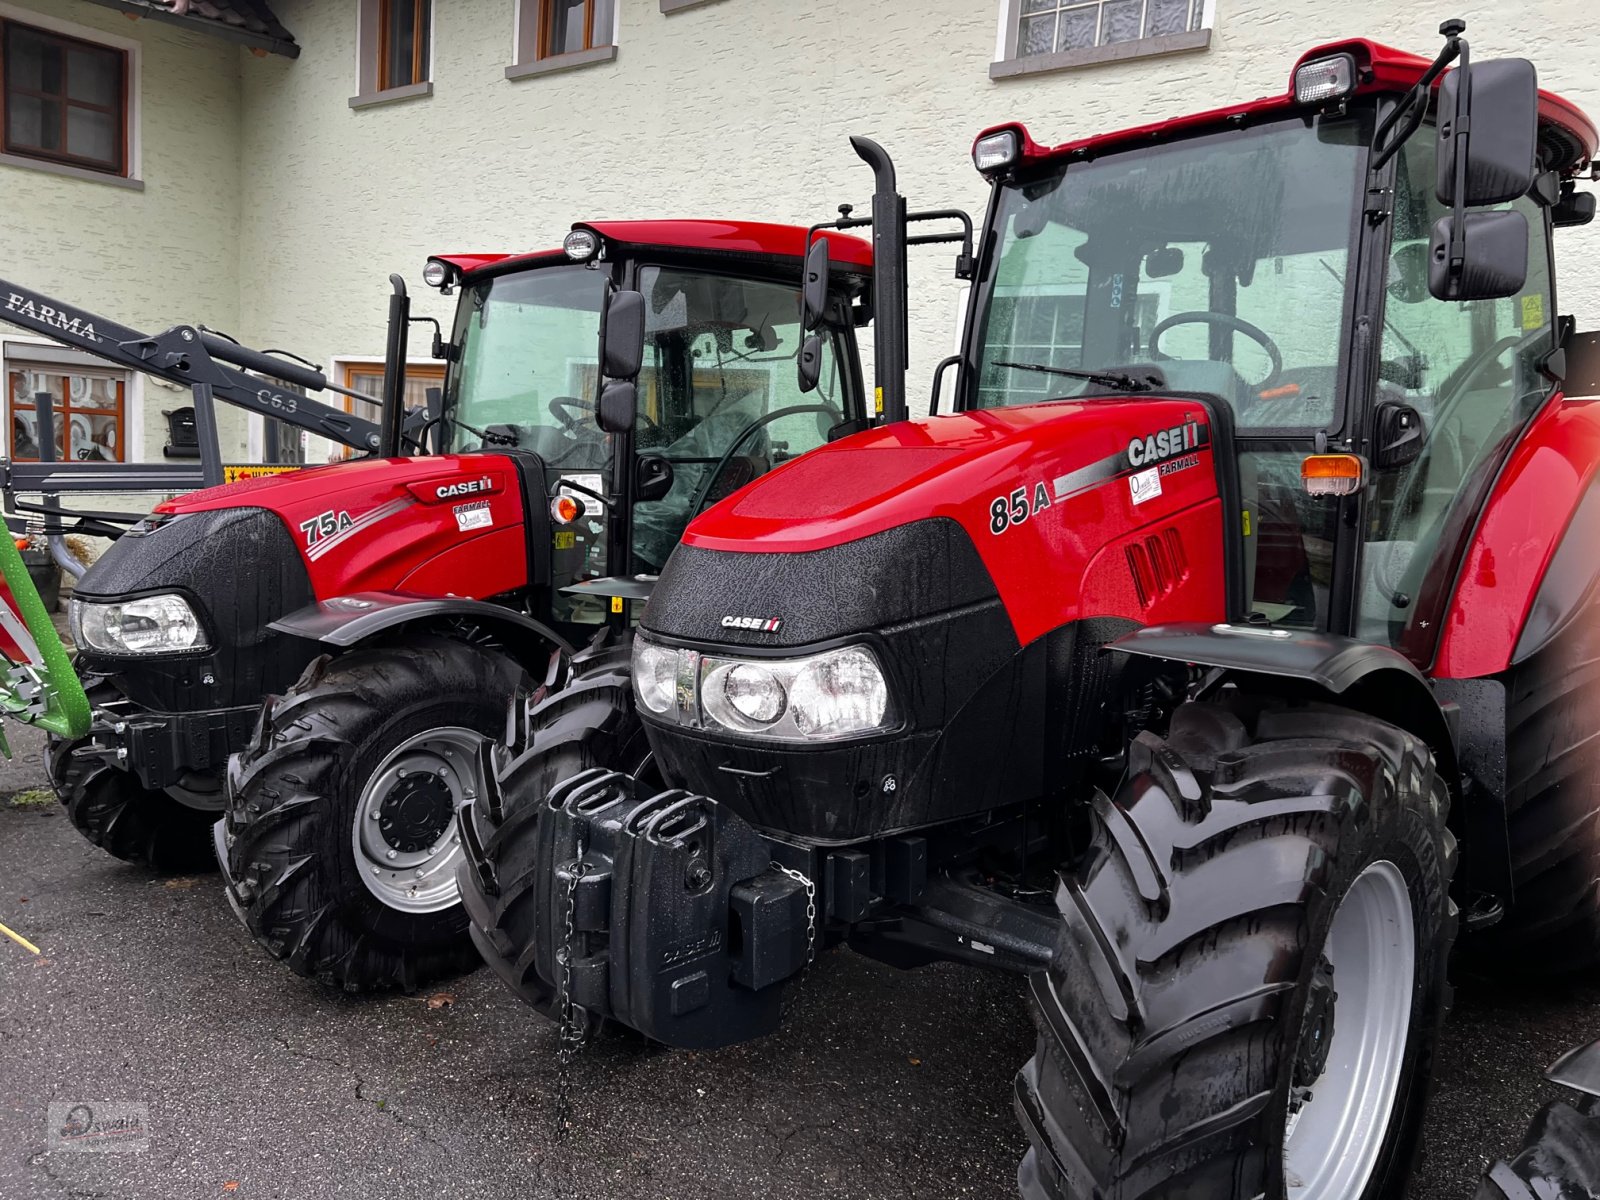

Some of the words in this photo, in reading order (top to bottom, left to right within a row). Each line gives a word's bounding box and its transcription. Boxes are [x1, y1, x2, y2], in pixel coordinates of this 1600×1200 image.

[5, 292, 97, 341] FARMA
[257, 389, 298, 413] C6.3
[1128, 427, 1182, 466] CASE
[1160, 453, 1200, 477] FARMALL
[436, 481, 478, 498] CASE
[452, 500, 491, 515] FARMALL
[300, 510, 354, 546] 75A
[721, 615, 763, 629] CASE
